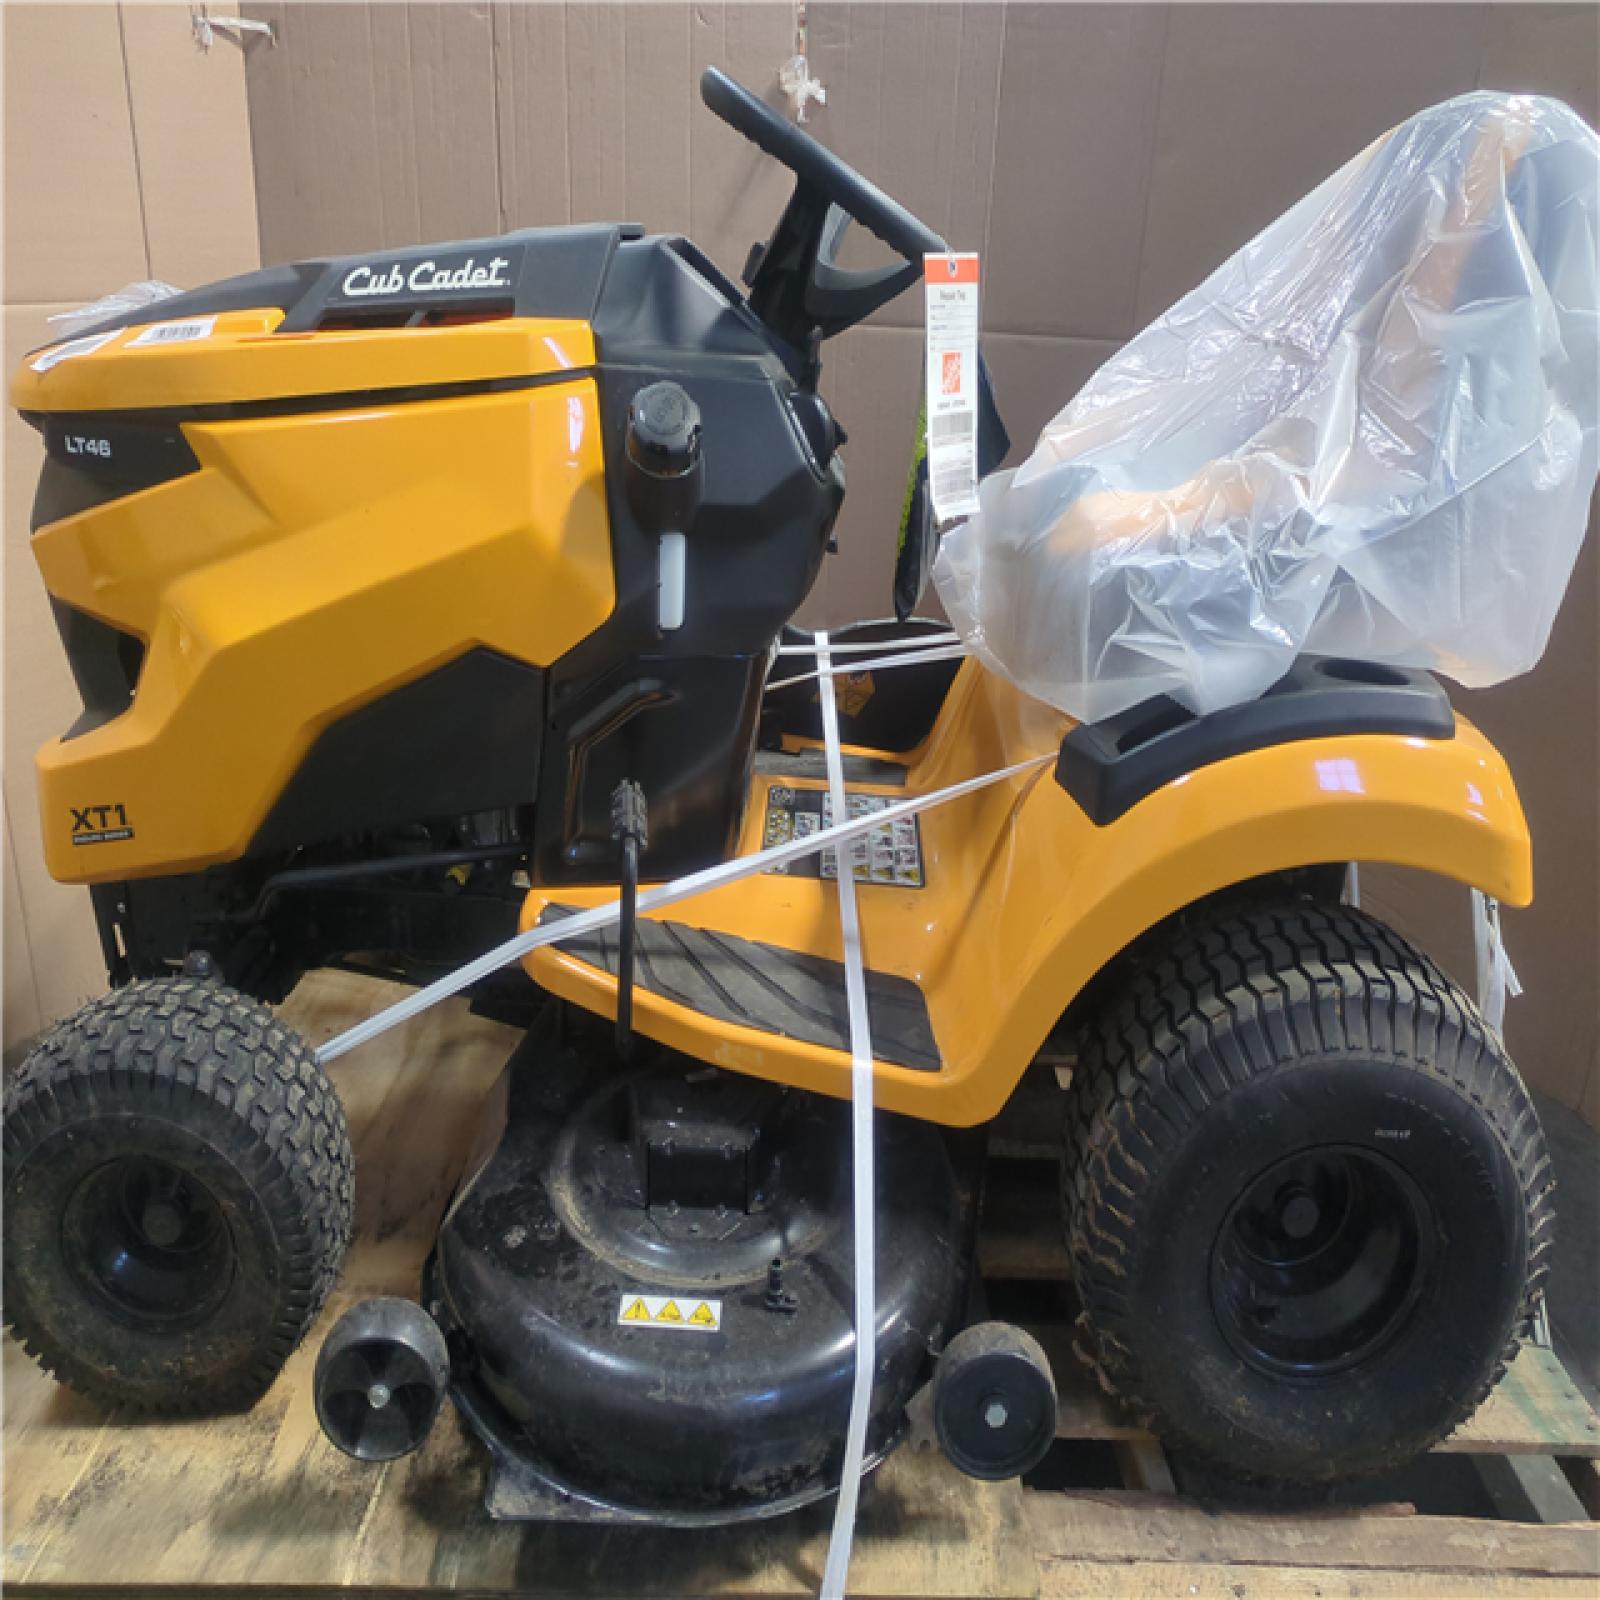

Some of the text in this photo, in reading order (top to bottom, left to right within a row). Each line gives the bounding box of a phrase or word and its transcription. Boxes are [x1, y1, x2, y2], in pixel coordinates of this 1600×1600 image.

[343, 257, 509, 296] Cub Cadet
[70, 804, 126, 831] XT1
